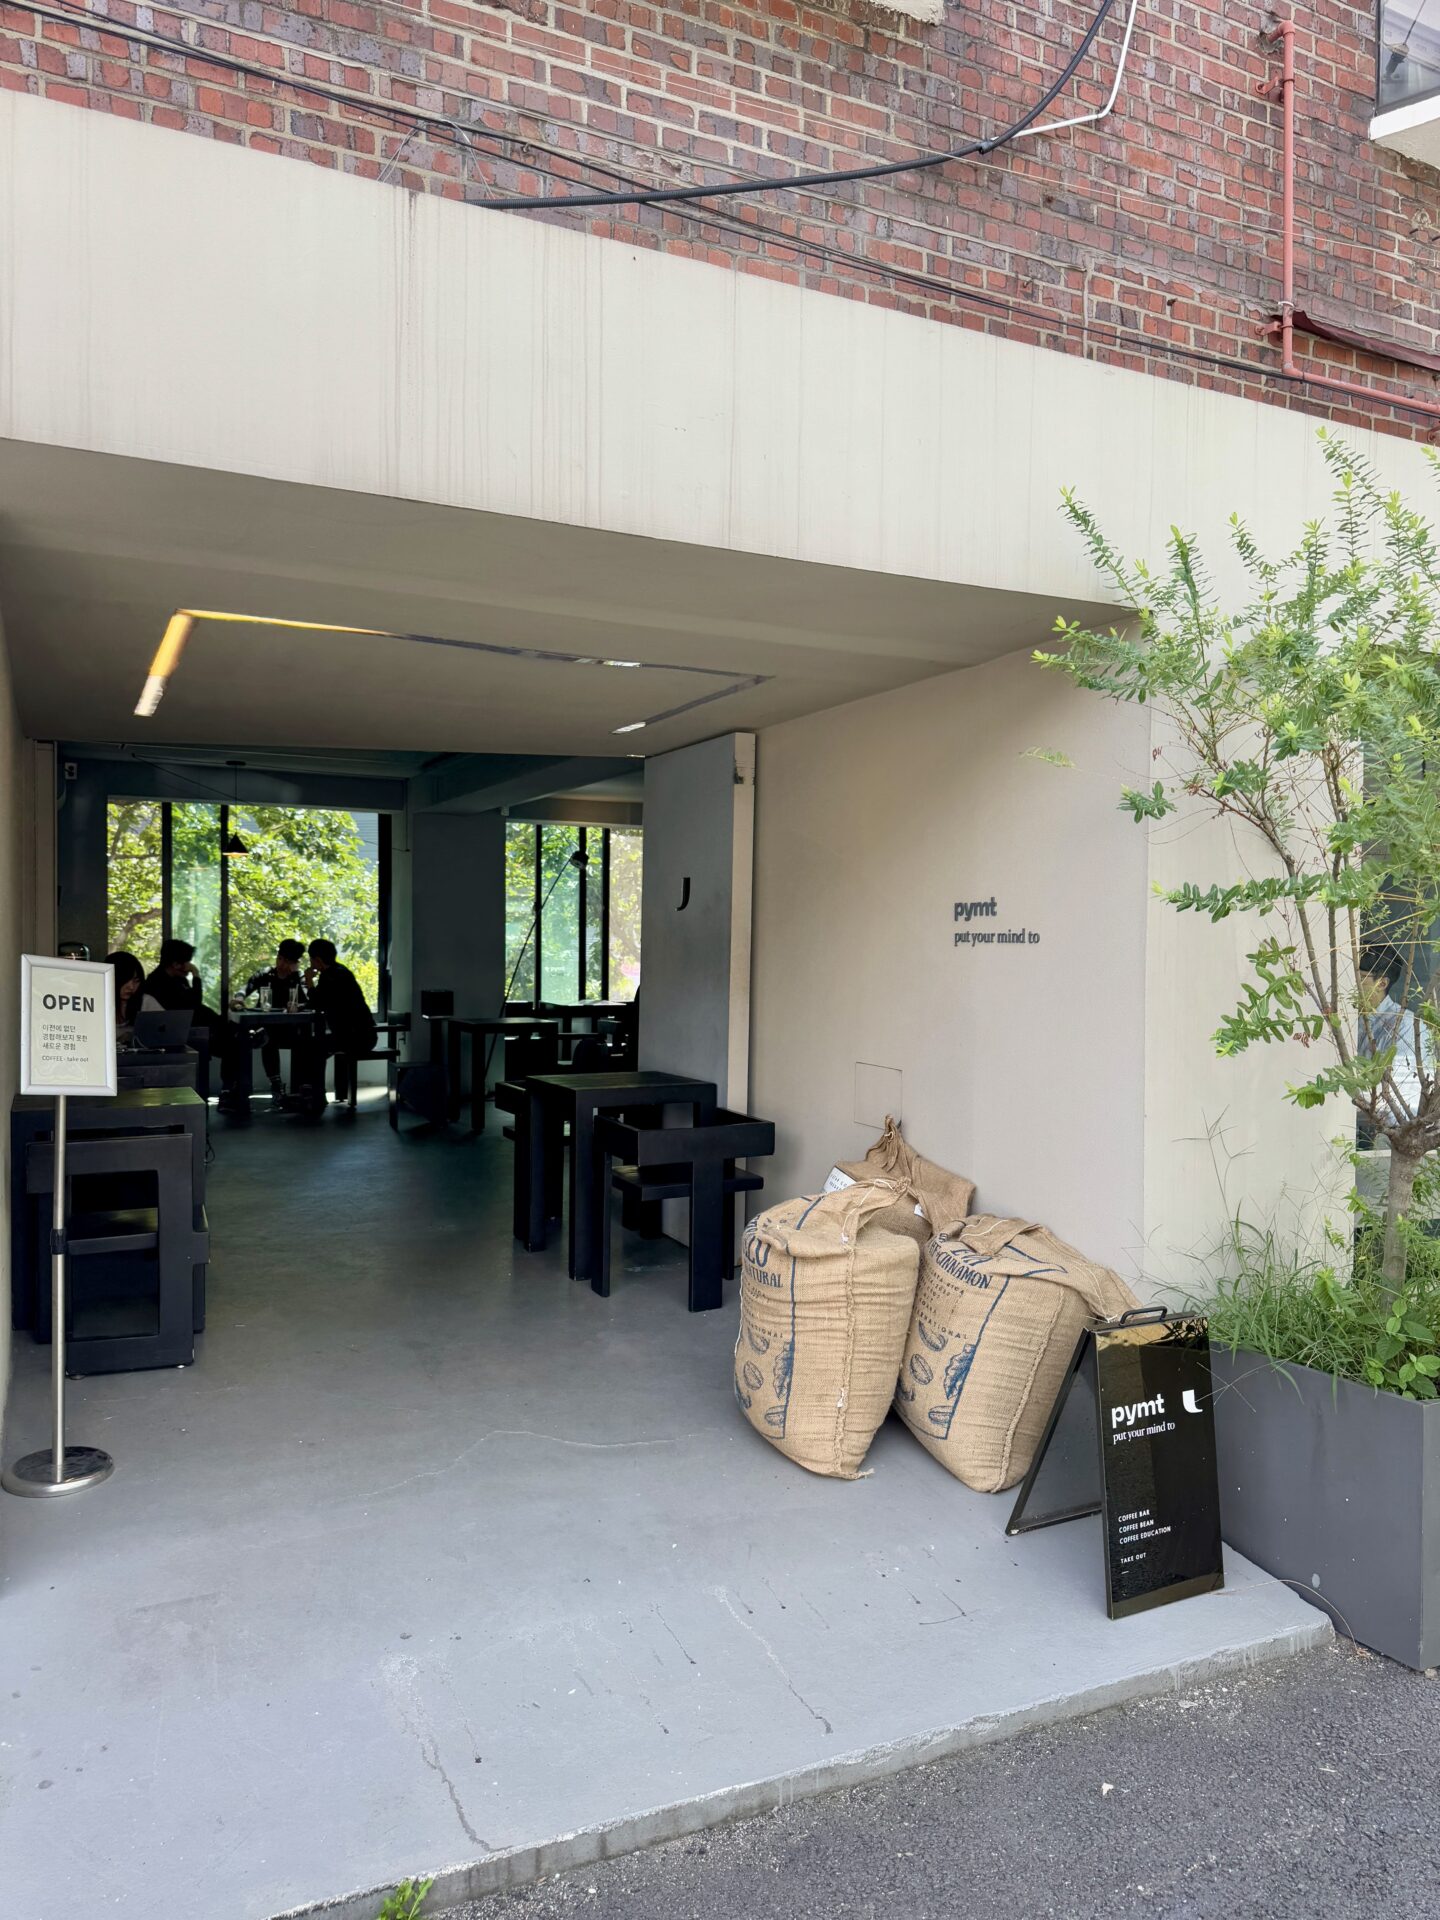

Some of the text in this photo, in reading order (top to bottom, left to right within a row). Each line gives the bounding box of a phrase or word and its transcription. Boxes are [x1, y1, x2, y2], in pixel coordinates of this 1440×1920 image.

[954, 896, 997, 922] pymt
[954, 928, 1040, 947] put your mind to
[42, 993, 95, 1013] OPEN
[1111, 1393, 1165, 1429] pymt
[1113, 1421, 1176, 1445] put your mind to
[1118, 1509, 1150, 1523] COFFEE BAR
[1118, 1519, 1154, 1534] COFFEE BEAN
[1119, 1525, 1171, 1545] COFFEE EDUCATION
[1120, 1552, 1147, 1564] TAKE OUT
